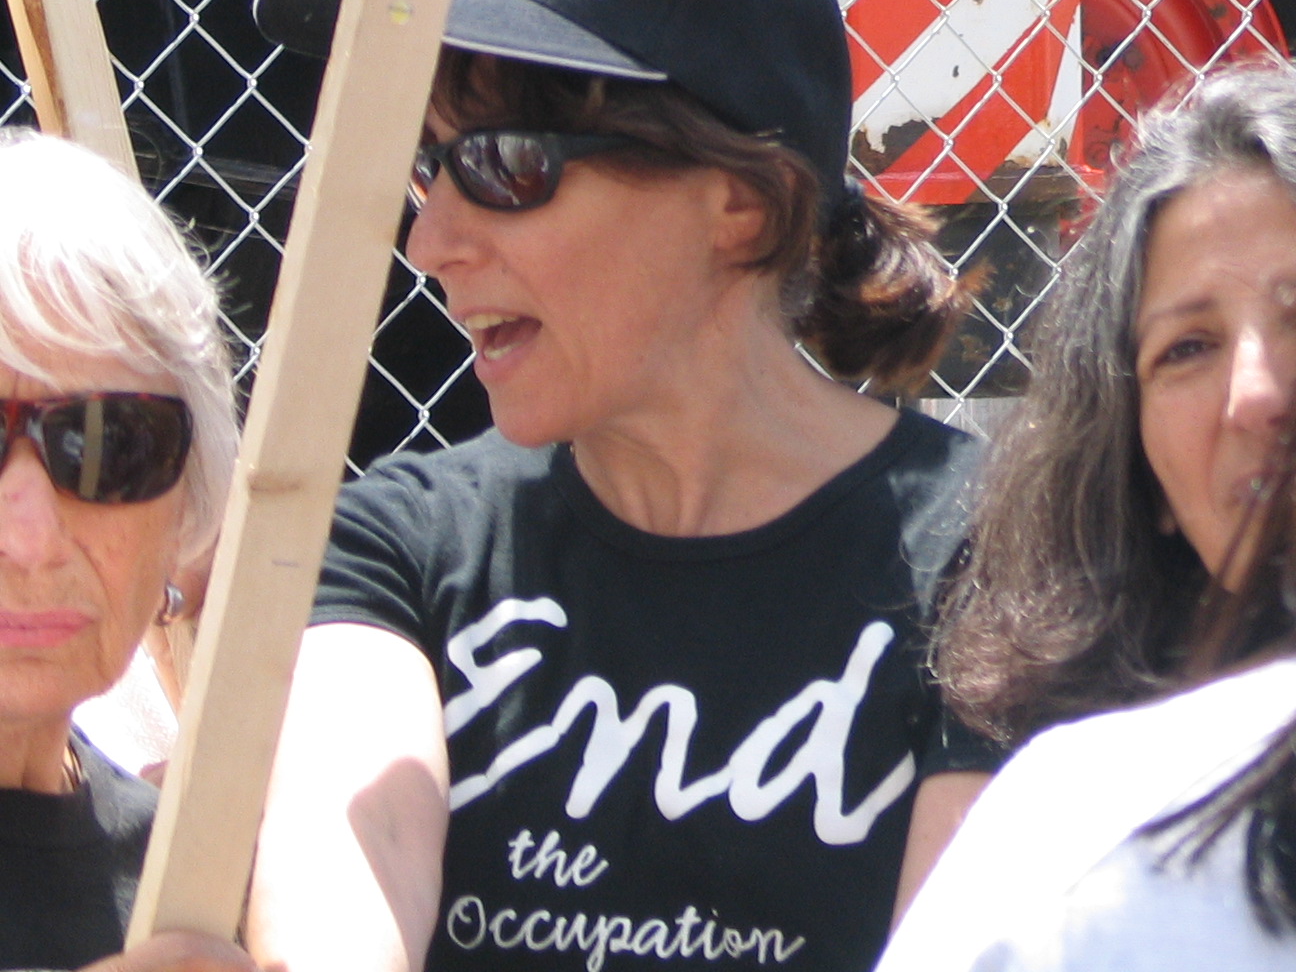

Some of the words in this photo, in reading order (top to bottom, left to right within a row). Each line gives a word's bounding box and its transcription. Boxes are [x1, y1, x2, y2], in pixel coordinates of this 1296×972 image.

[446, 596, 917, 846] End
[507, 828, 609, 887] the
[446, 894, 806, 972] Occupation
